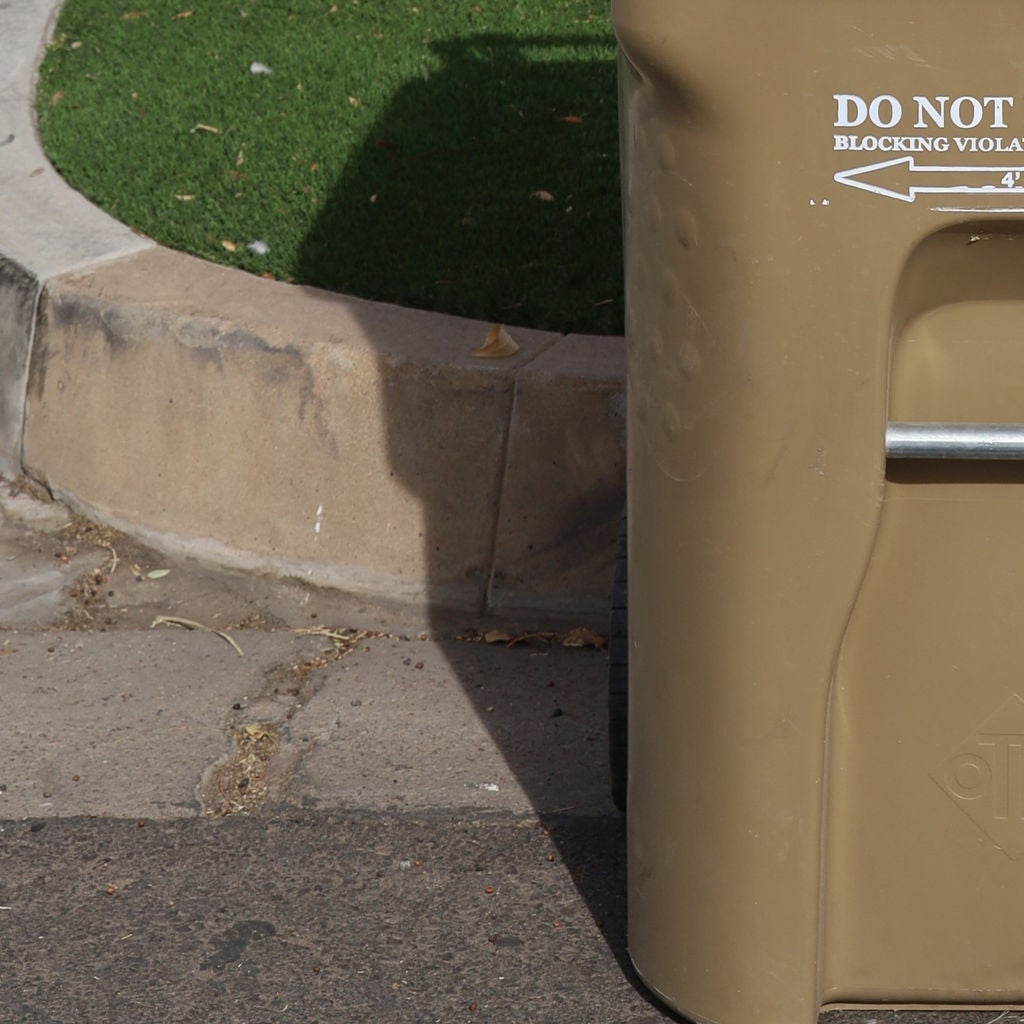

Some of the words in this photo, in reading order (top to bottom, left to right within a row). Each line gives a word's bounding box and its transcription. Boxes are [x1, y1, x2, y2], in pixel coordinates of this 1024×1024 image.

[833, 93, 902, 129] DO
[913, 95, 1014, 129] NOT
[833, 134, 950, 153] BLOCKING
